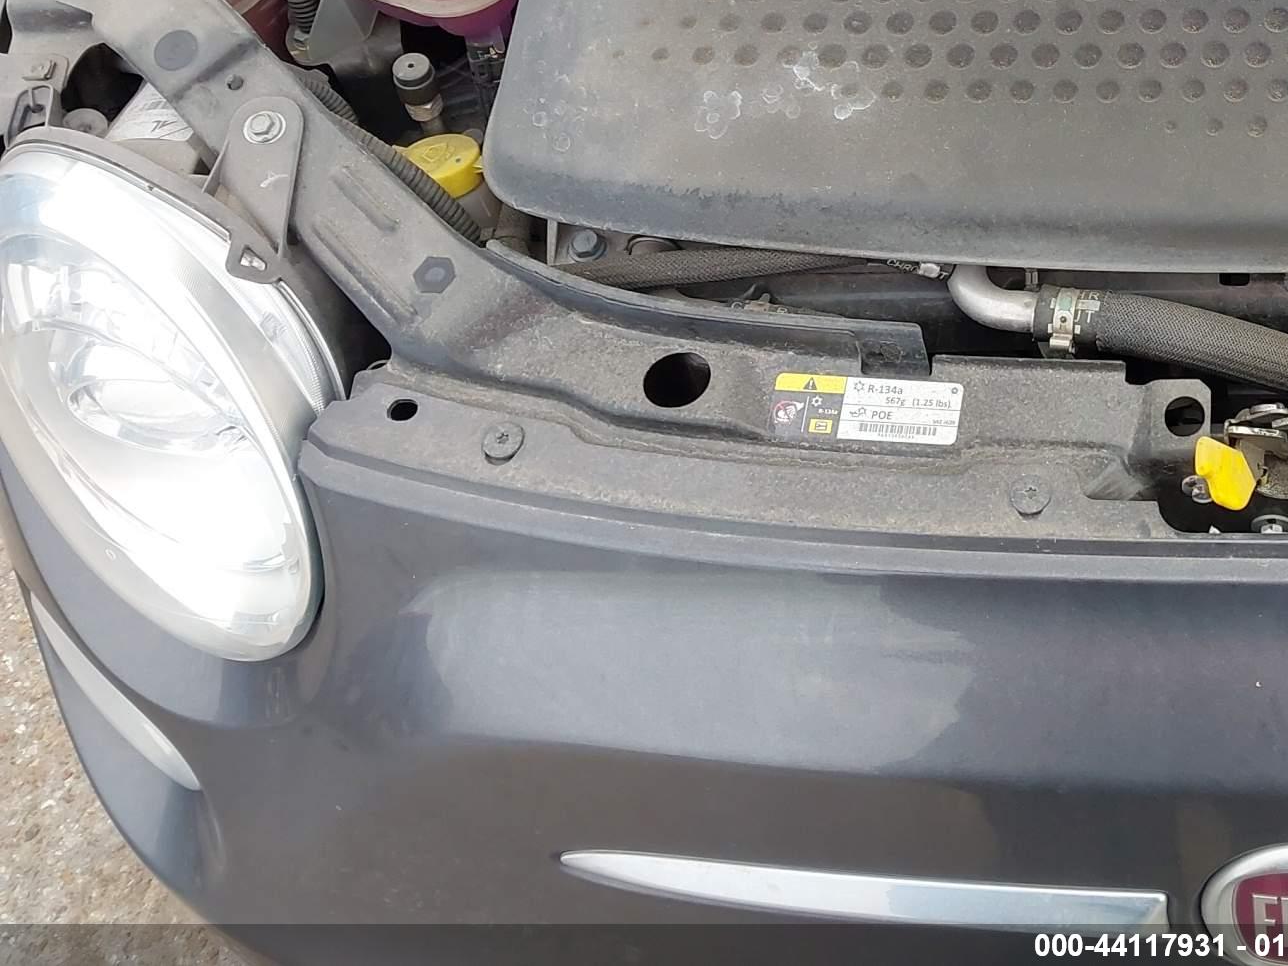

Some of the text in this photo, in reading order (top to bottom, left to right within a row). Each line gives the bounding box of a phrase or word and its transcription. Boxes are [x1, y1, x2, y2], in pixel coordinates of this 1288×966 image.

[867, 384, 904, 395] R-134a
[885, 396, 907, 407] 567g
[912, 398, 934, 408] (1.25
[871, 410, 894, 420] POE
